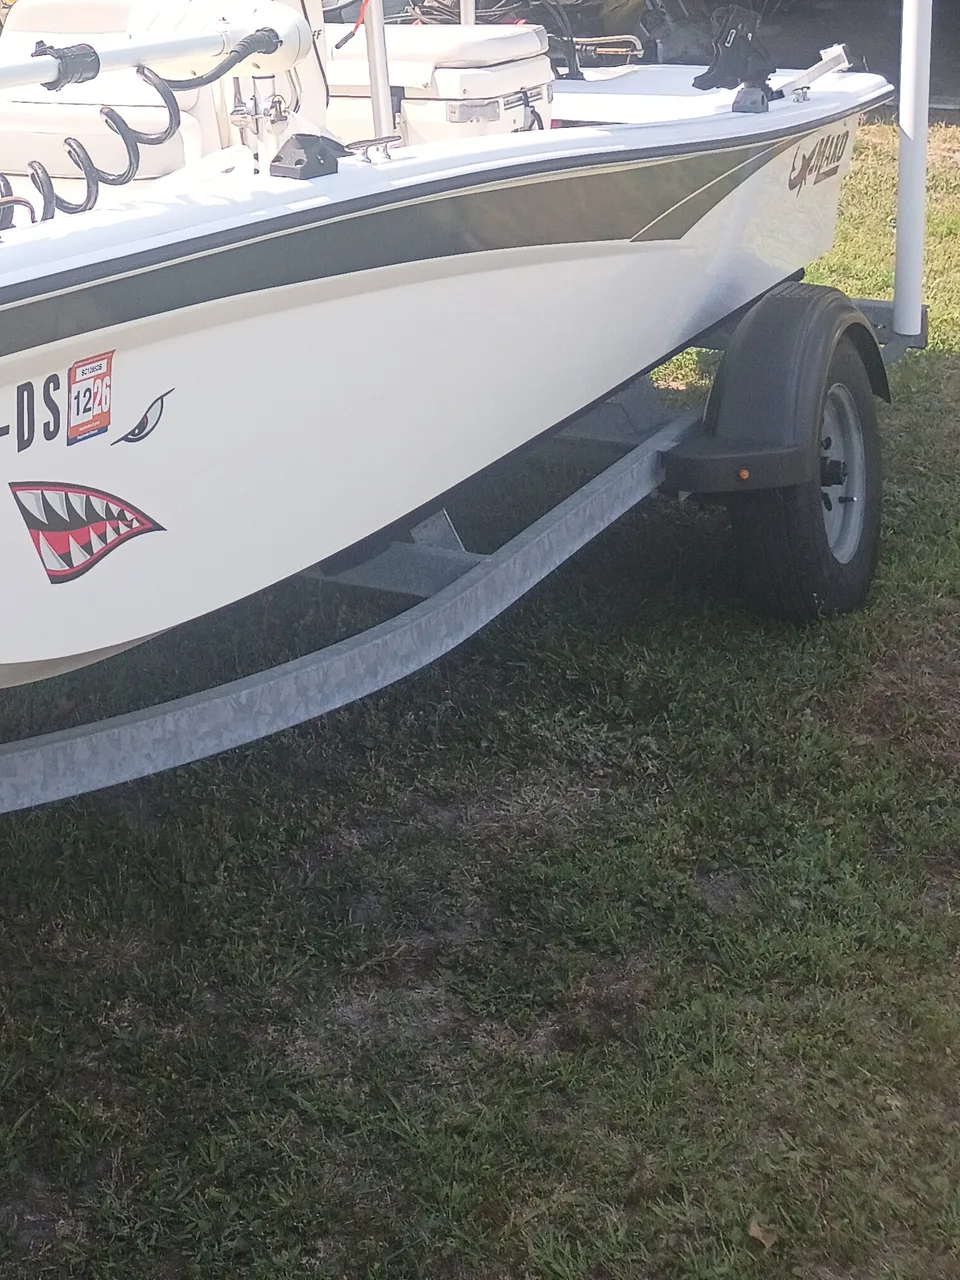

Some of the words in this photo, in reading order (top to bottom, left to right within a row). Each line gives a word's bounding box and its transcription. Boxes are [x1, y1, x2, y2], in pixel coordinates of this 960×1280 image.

[808, 130, 849, 185] MAKO
[74, 387, 92, 416] 12
[93, 376, 111, 415] 26
